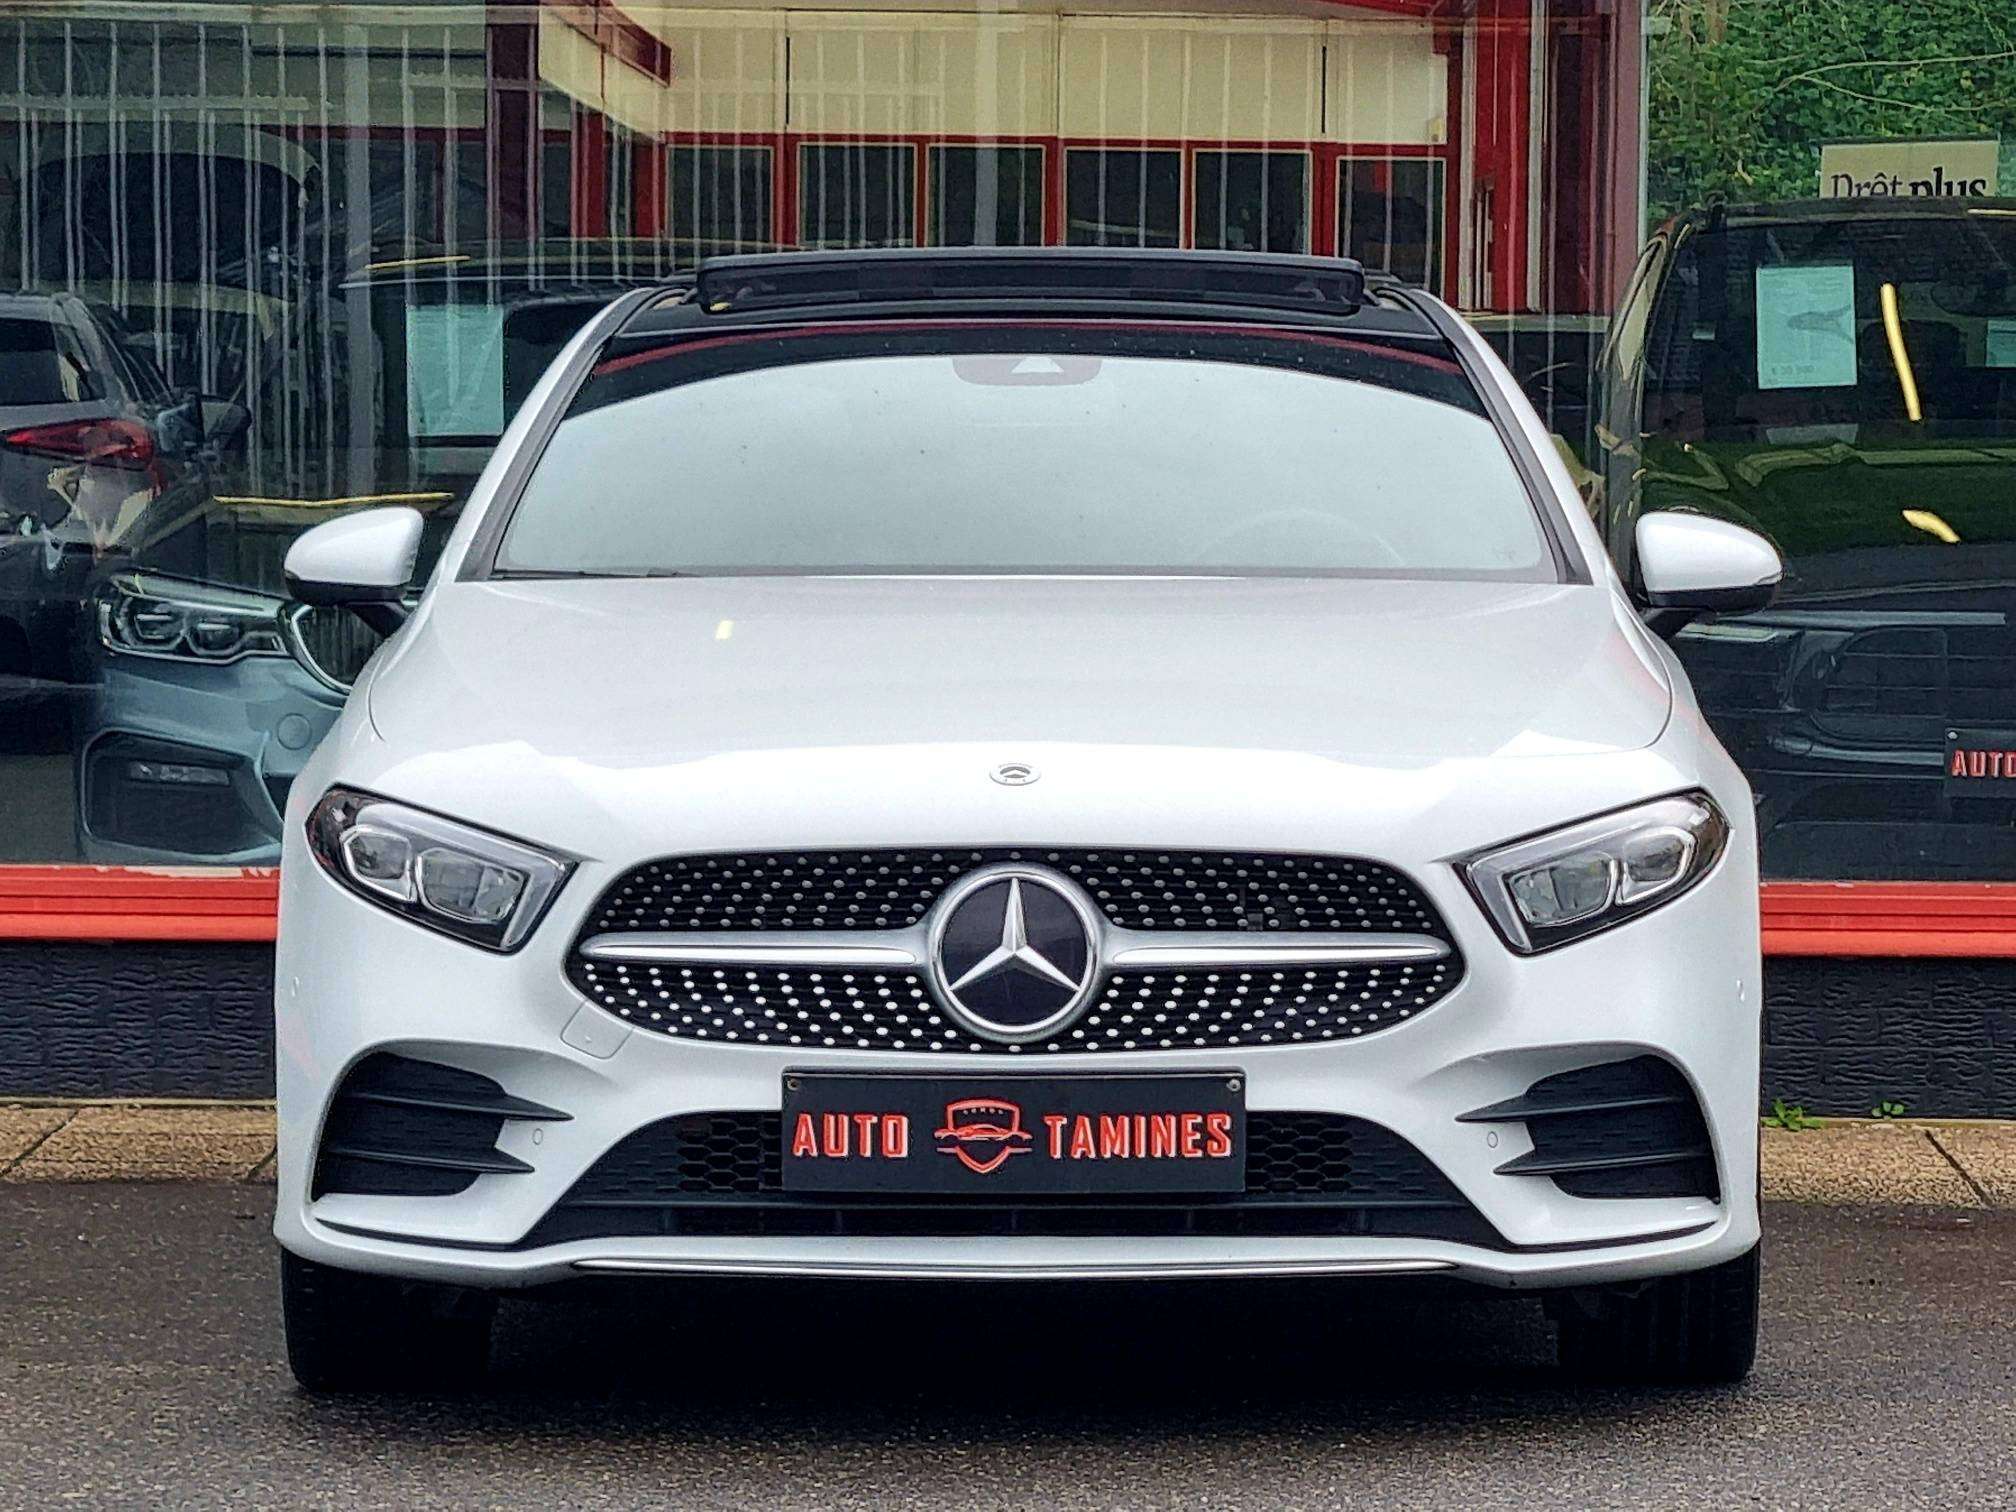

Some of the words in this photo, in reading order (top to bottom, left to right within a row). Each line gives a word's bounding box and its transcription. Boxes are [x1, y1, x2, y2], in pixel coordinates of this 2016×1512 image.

[1951, 750, 2016, 778] AUTO
[792, 1113, 909, 1158] AUTO
[1043, 1113, 1232, 1159] TAMINES
